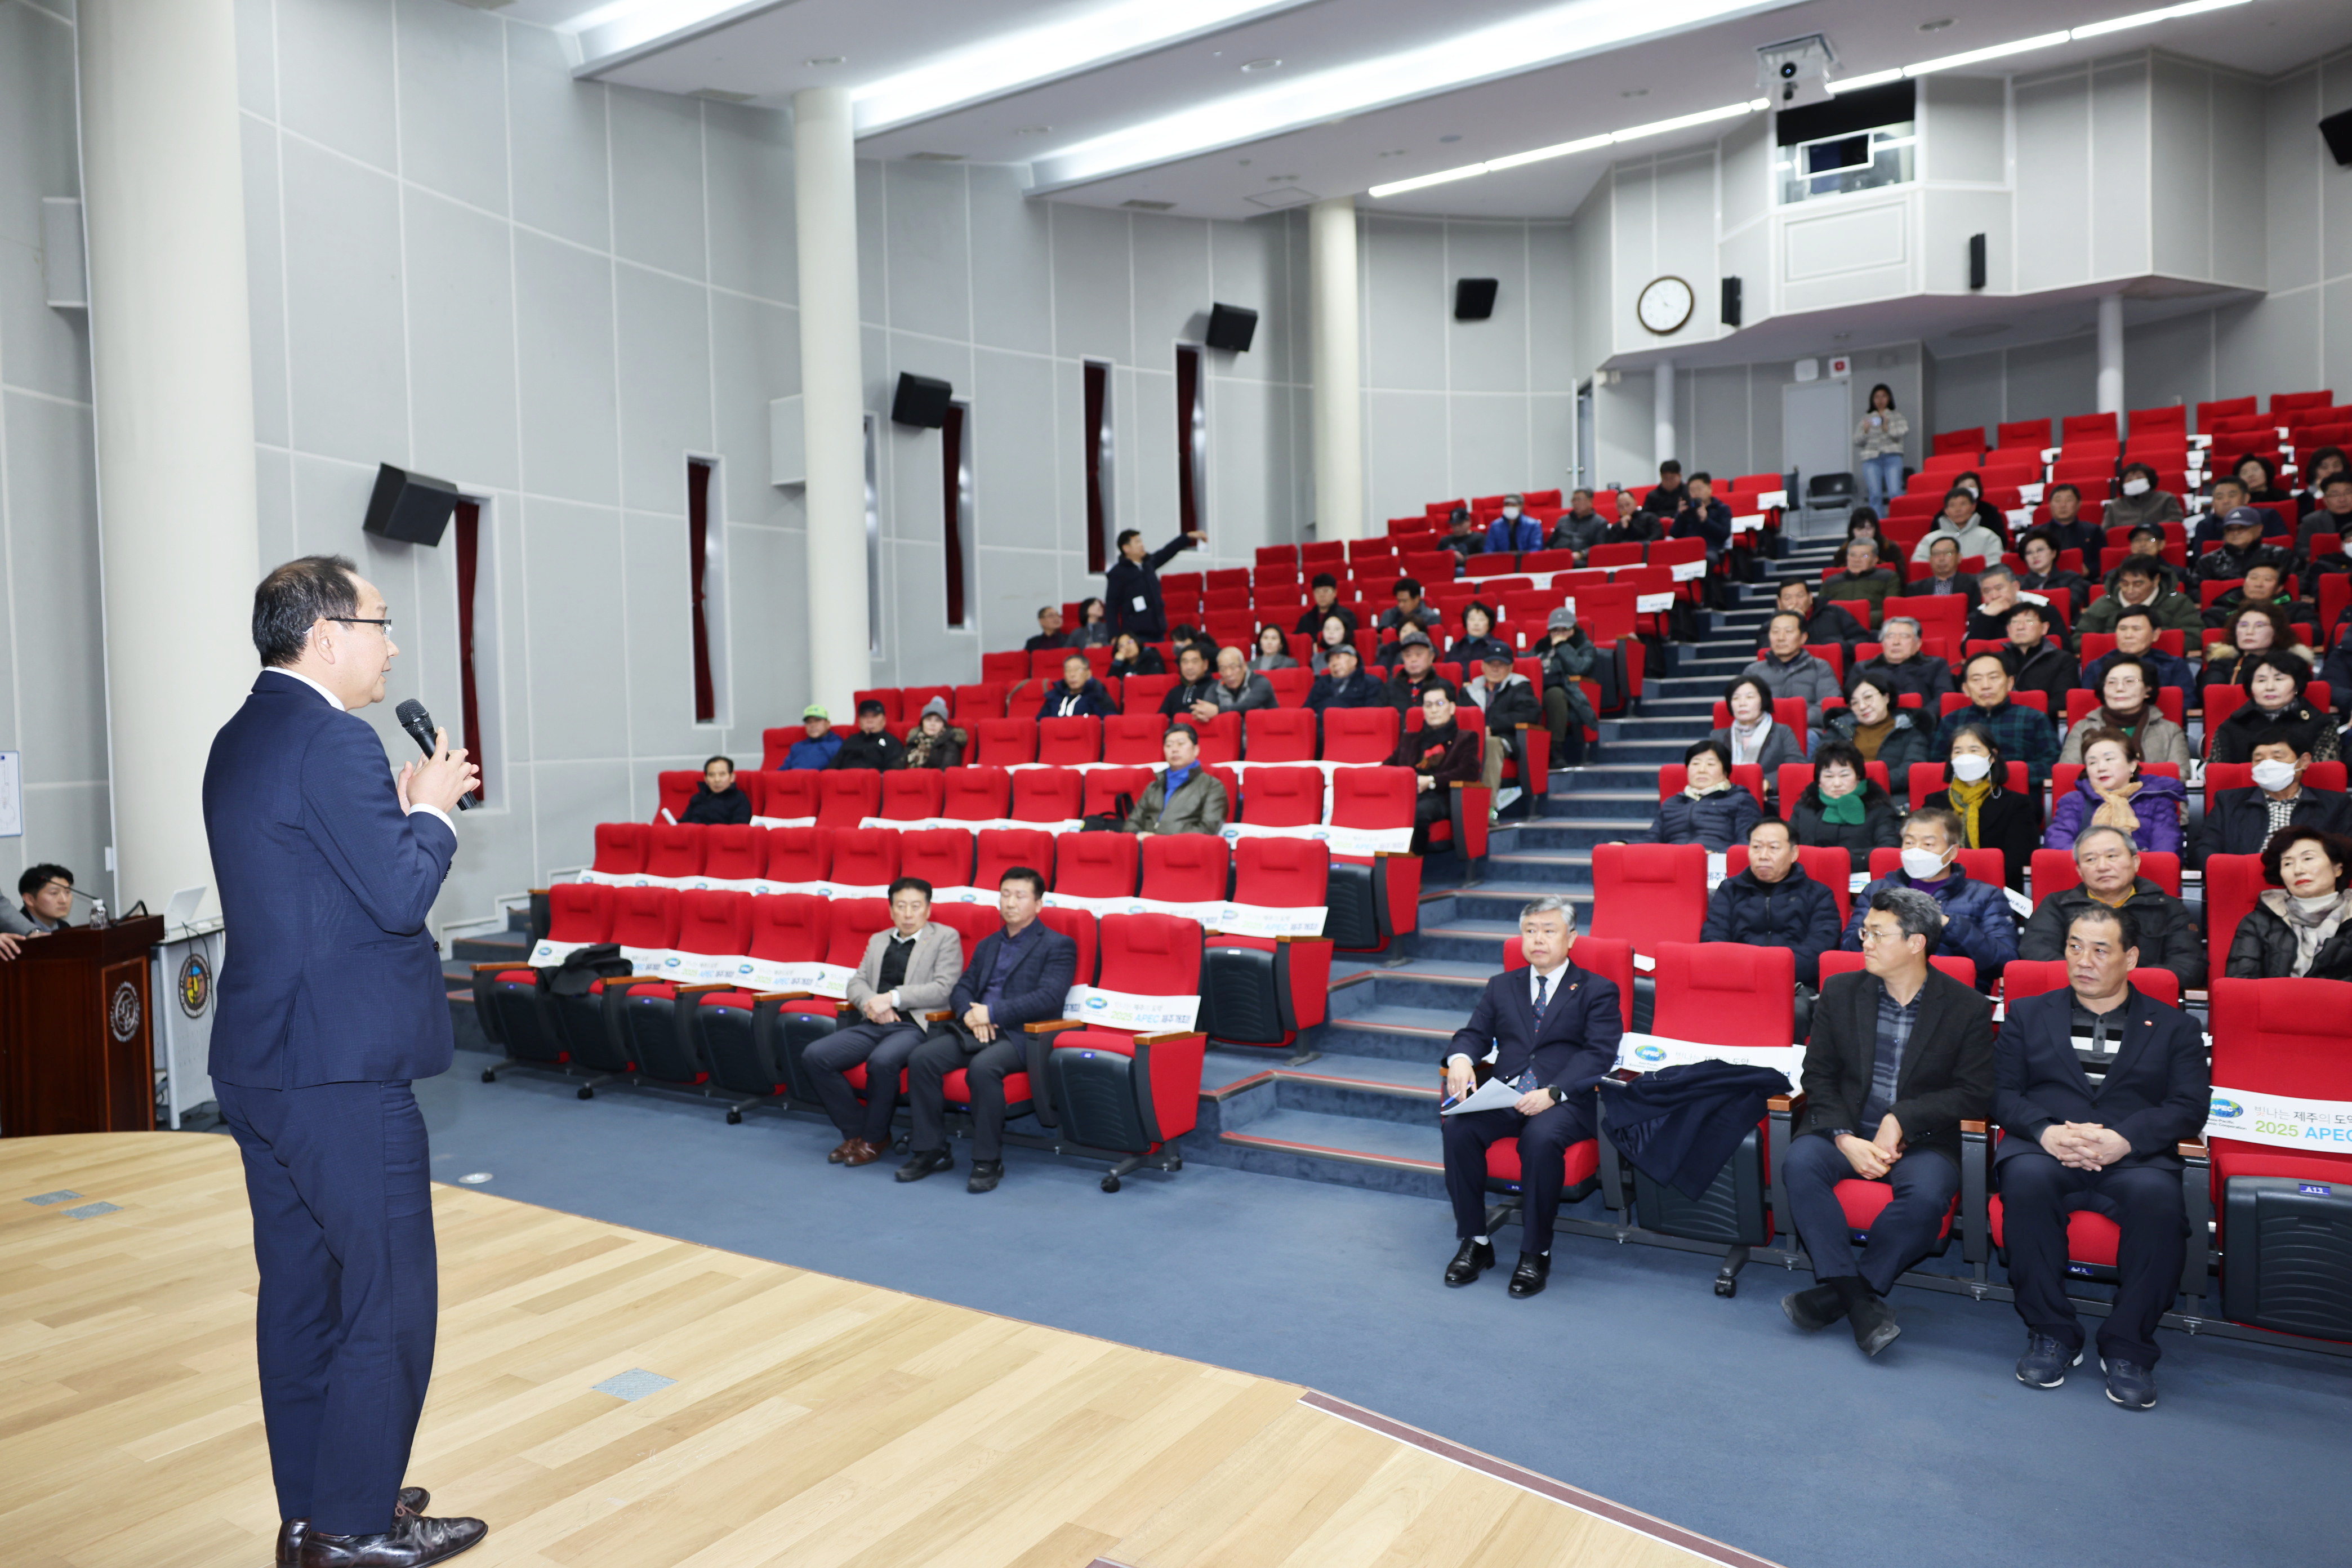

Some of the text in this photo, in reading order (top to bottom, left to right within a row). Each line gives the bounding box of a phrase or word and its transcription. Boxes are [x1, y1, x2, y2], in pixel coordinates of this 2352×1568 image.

[1111, 1010, 1133, 1021] 2025
[1135, 1014, 1160, 1023] APEC
[2211, 1103, 2234, 1112] APEC
[2255, 1106, 2291, 1121] 빛나는
[2293, 1111, 2330, 1124] 제주의
[2255, 1120, 2298, 1137] 2025
